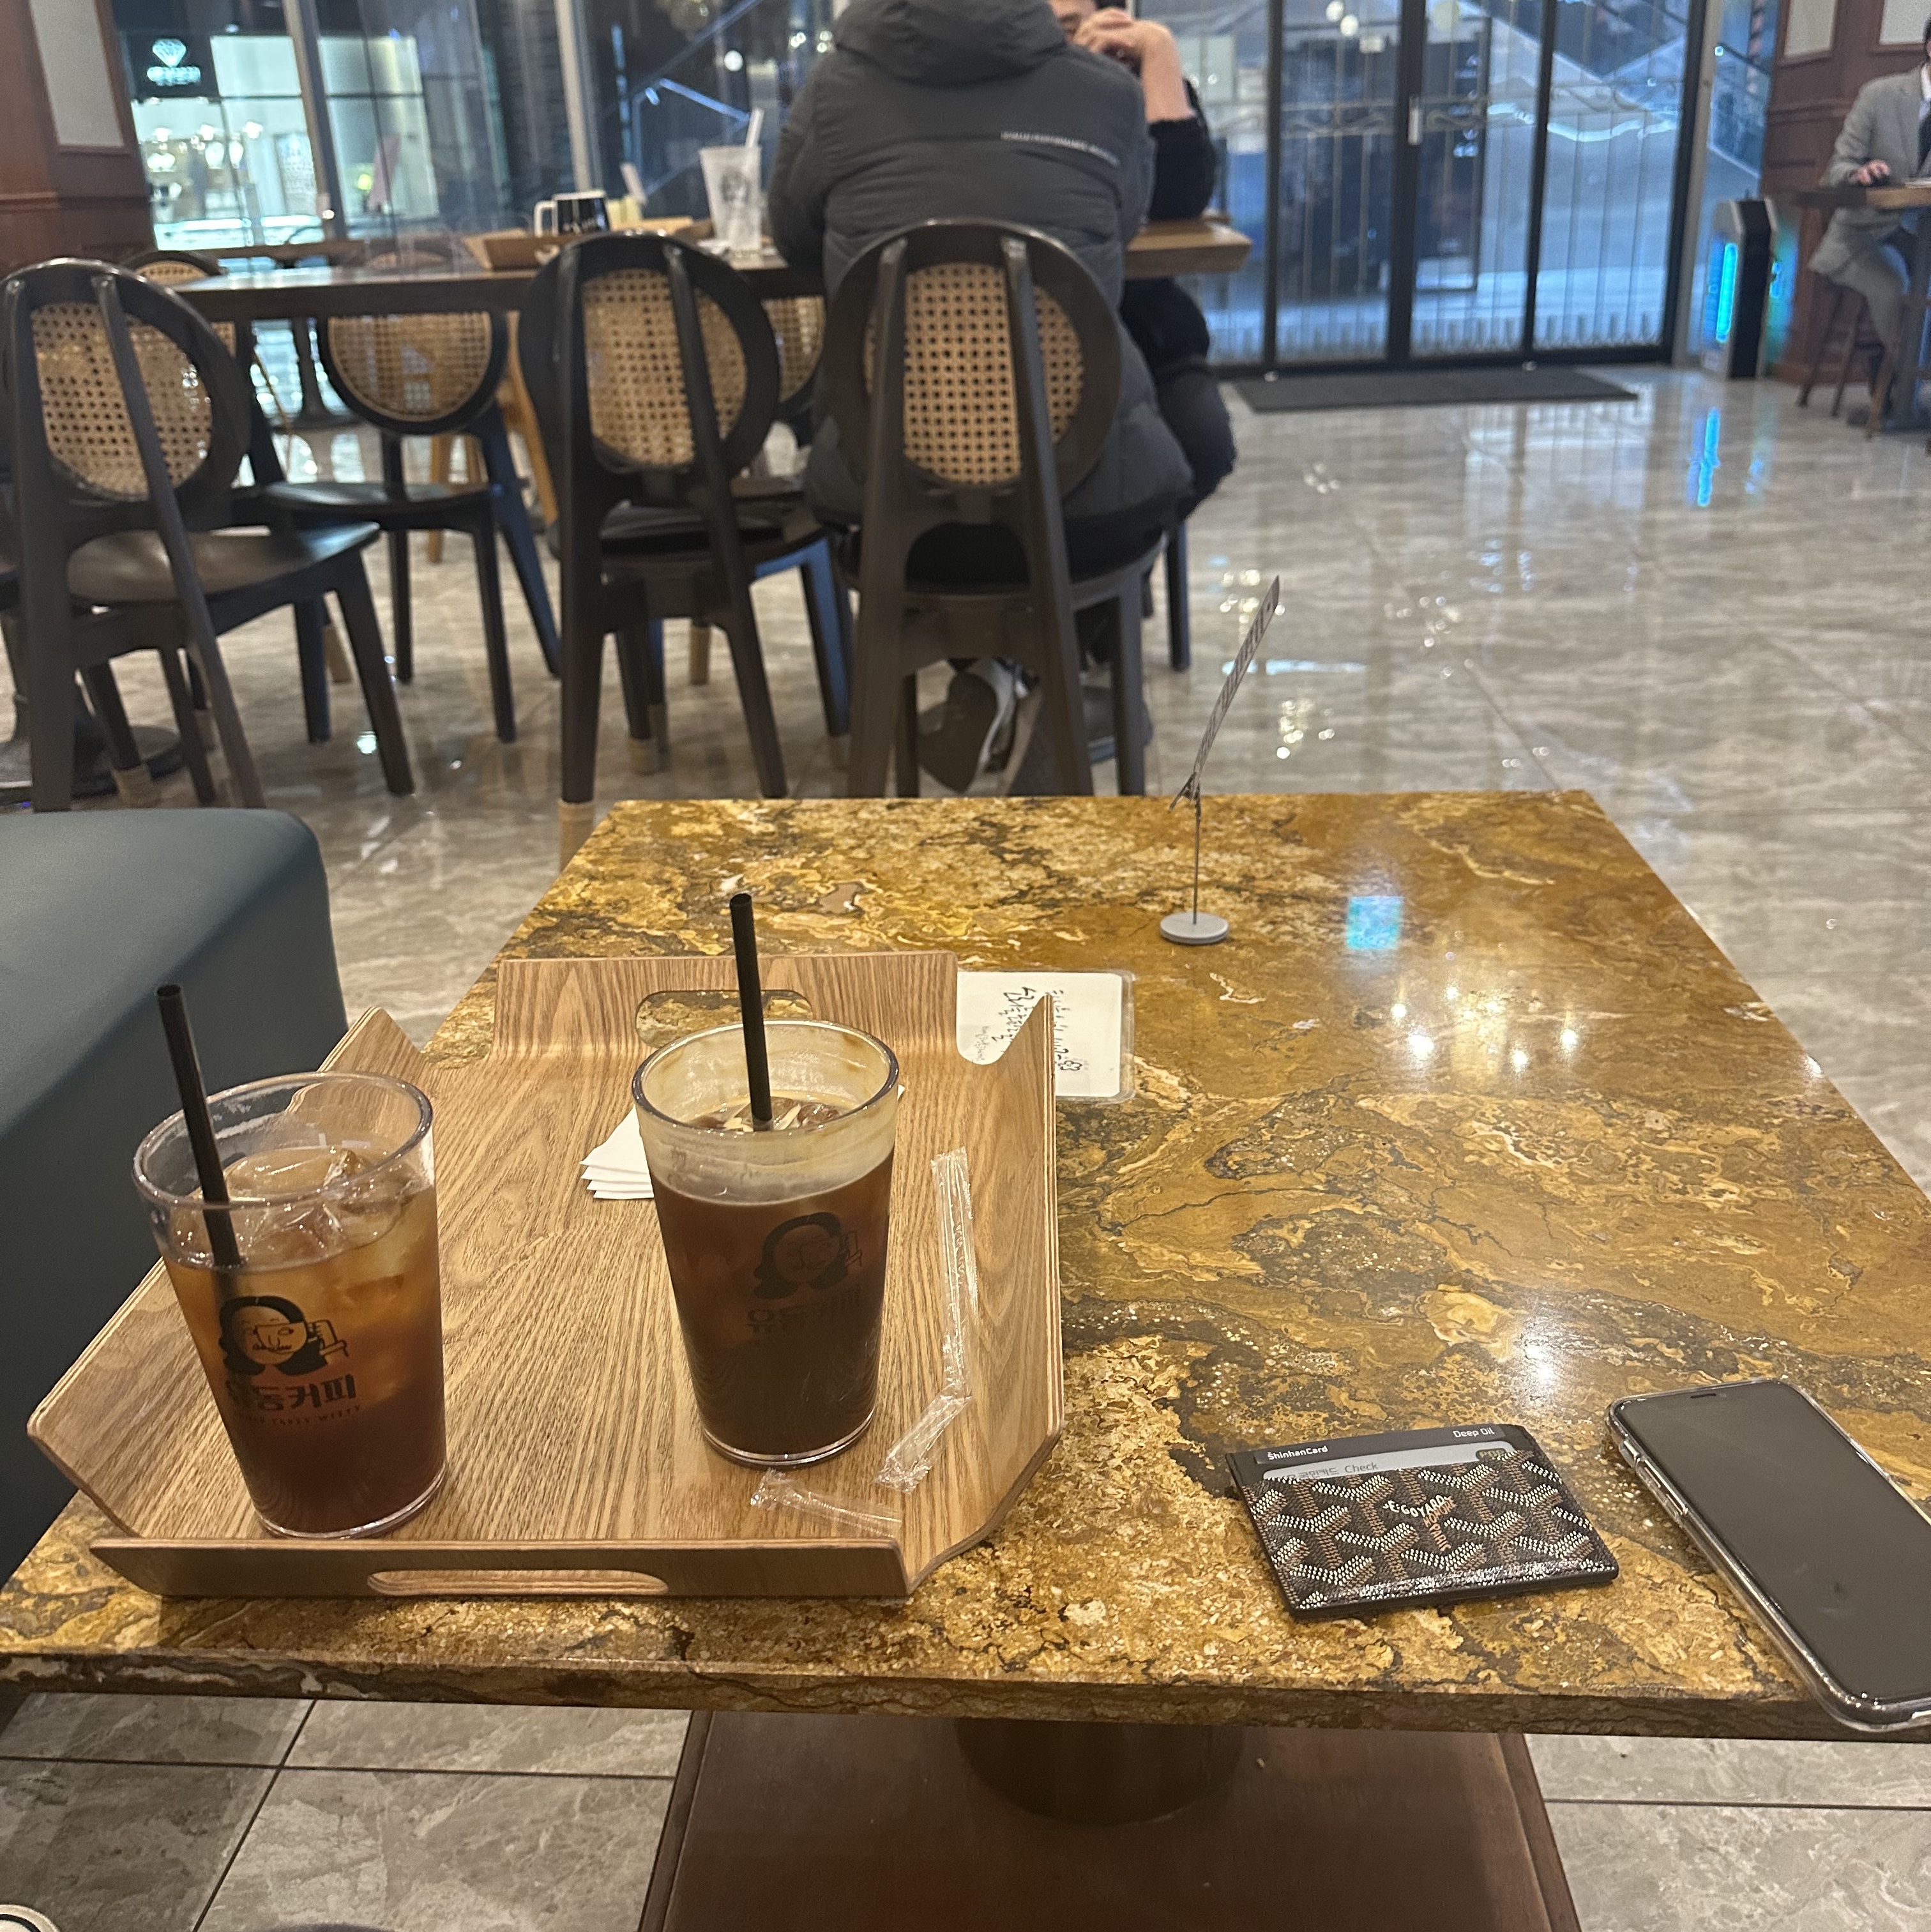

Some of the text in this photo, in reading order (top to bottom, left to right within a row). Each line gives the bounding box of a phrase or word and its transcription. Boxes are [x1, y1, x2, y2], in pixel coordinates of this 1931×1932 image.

[225, 1374, 357, 1411] 동커피
[1453, 1427, 1495, 1438] Deep Oil
[1267, 1445, 1328, 1461] ShinhanCard
[1344, 1462, 1378, 1473] Check
